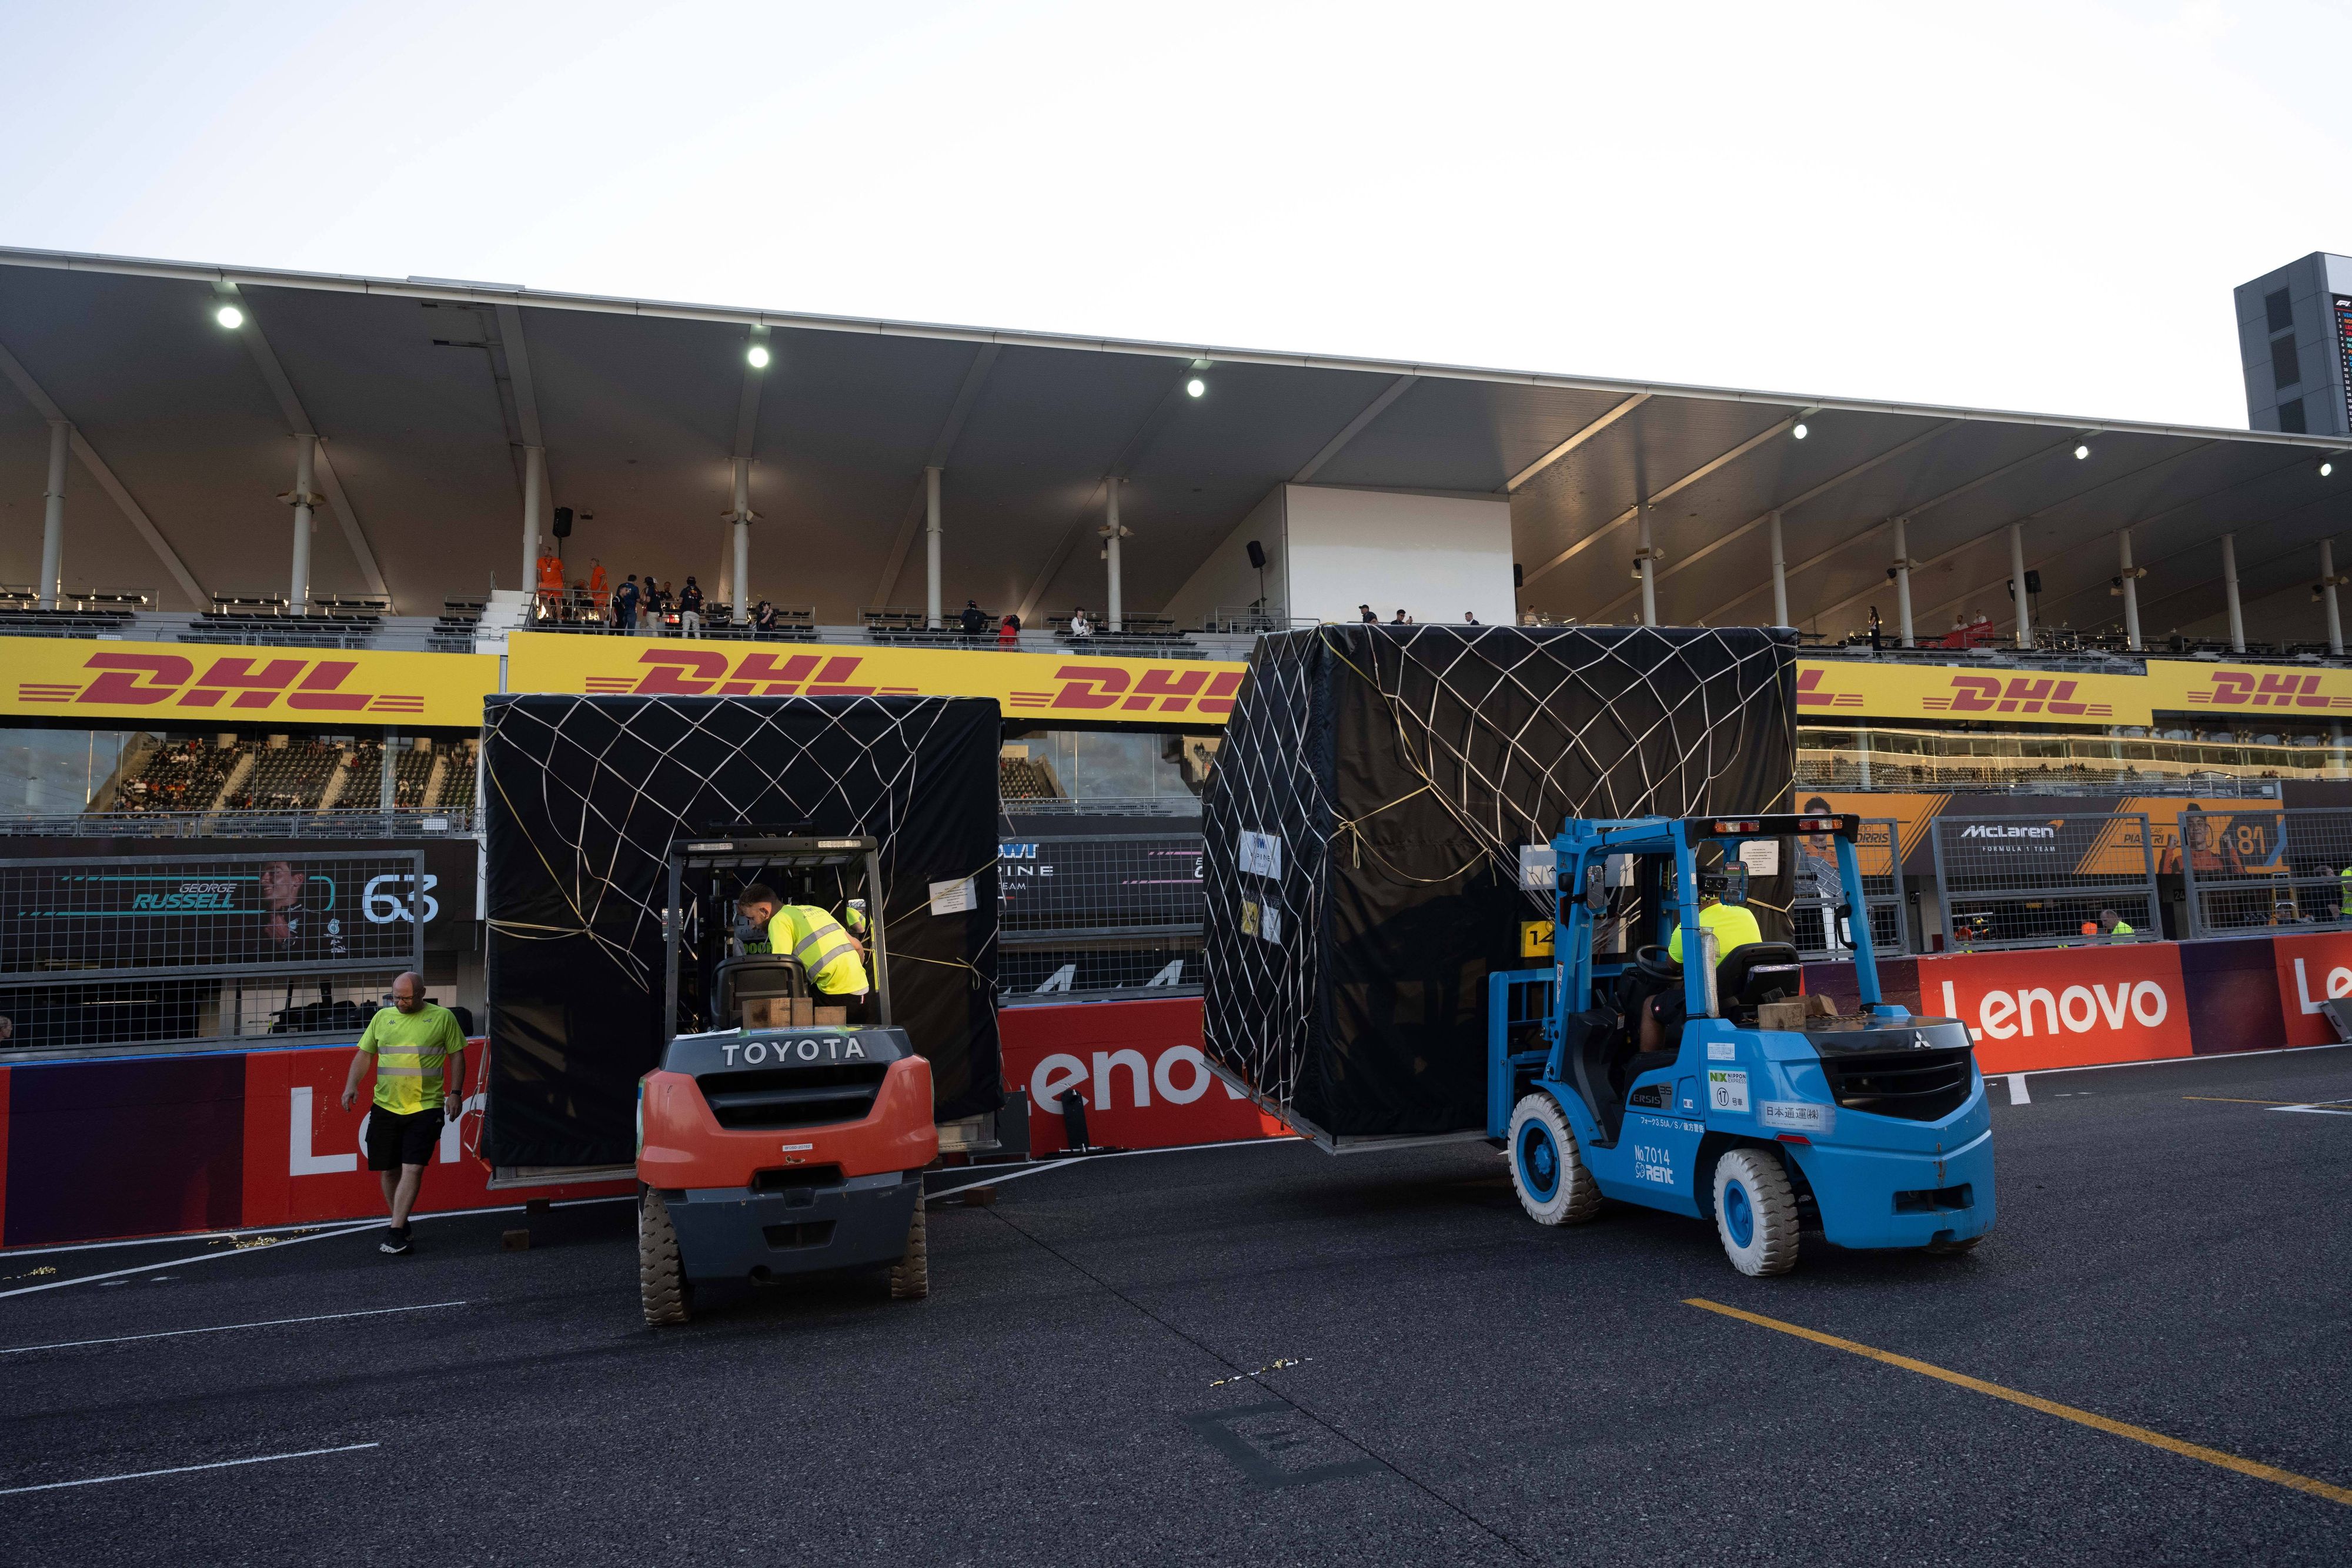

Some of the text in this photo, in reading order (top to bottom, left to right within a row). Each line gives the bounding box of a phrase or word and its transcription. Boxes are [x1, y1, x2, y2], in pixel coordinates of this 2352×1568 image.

[76, 652, 374, 711] DHL
[635, 648, 877, 696] DHL
[1051, 666, 1242, 713] DHL
[1950, 676, 2088, 716] DHL
[2211, 671, 2331, 707] DHL
[1960, 825, 2054, 838] McLaren
[2237, 825, 2266, 855] 81
[132, 893, 235, 909] RUSSELL
[179, 883, 237, 893] GEORGE
[362, 874, 439, 924] 63
[2174, 891, 2185, 900] 24
[1530, 930, 1555, 945] 14
[1942, 980, 2168, 1041] Lenovo
[722, 1038, 865, 1066] TOYOTA
[1709, 1072, 1728, 1082] NX
[1633, 1094, 1661, 1105] ERSIS
[1732, 1098, 1743, 1106] 号車
